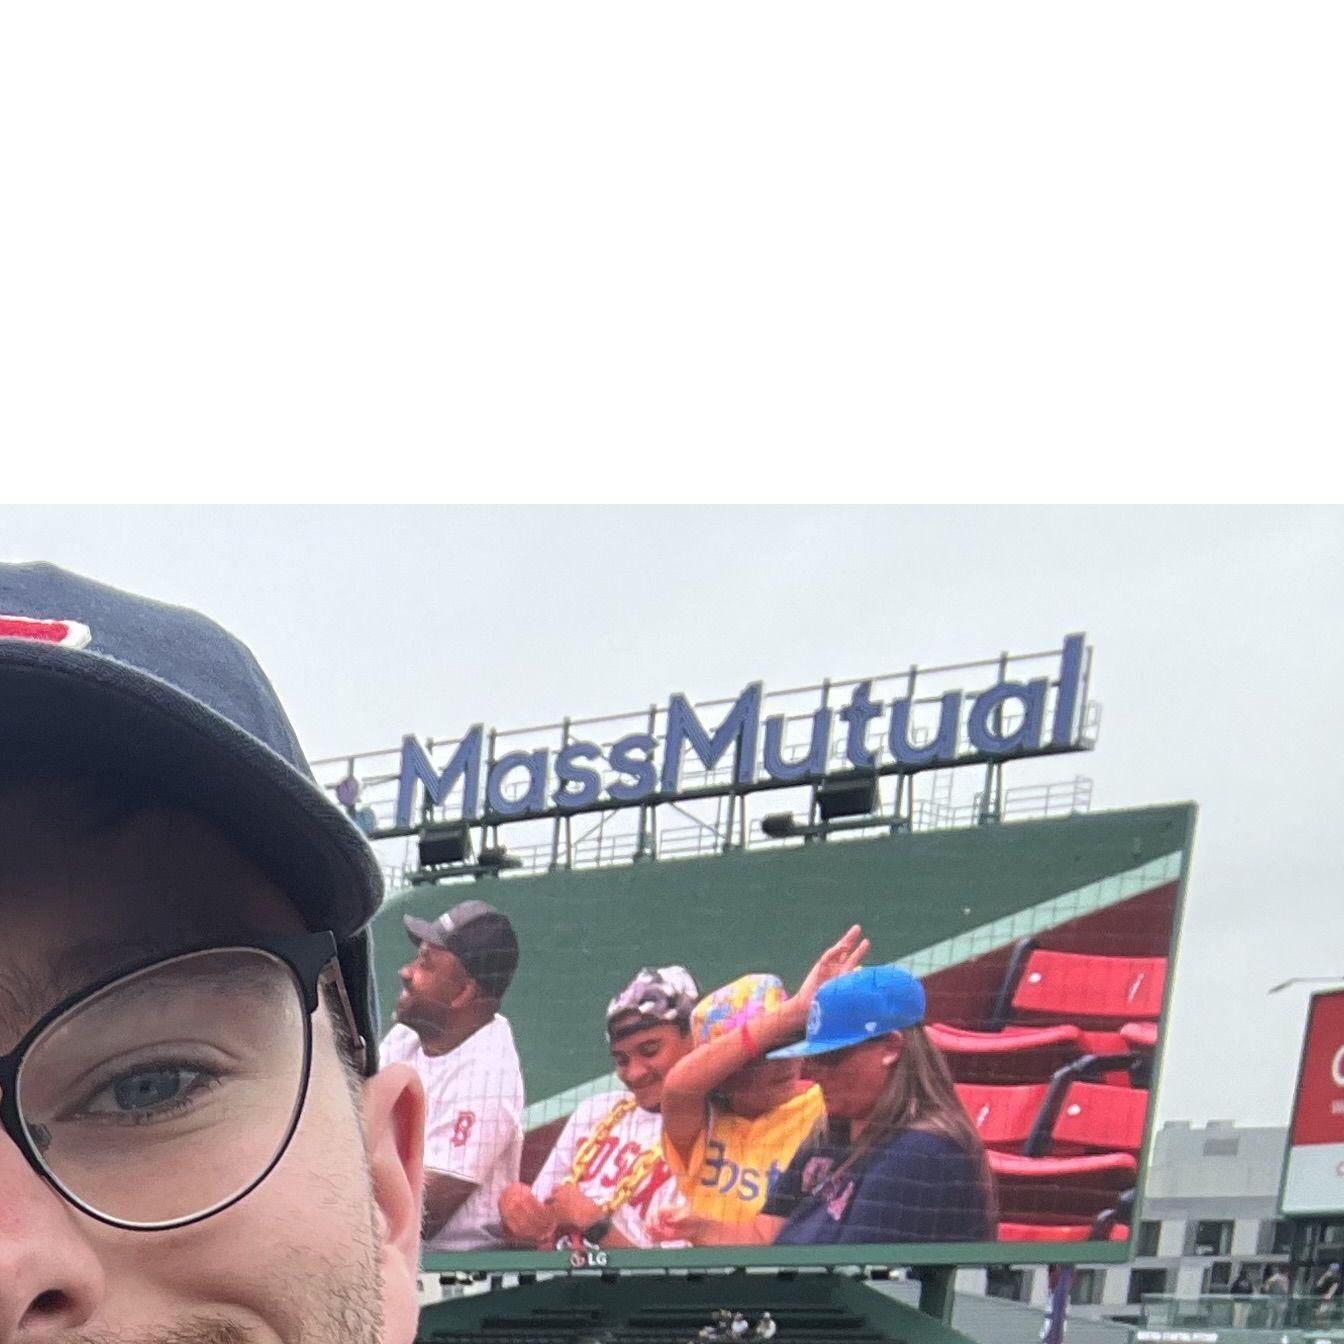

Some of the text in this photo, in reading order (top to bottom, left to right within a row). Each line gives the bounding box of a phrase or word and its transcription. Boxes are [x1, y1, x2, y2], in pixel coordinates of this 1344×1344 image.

[394, 632, 1087, 827] MassMutual
[702, 1140, 779, 1201] Bost
[588, 1252, 608, 1266] LG
